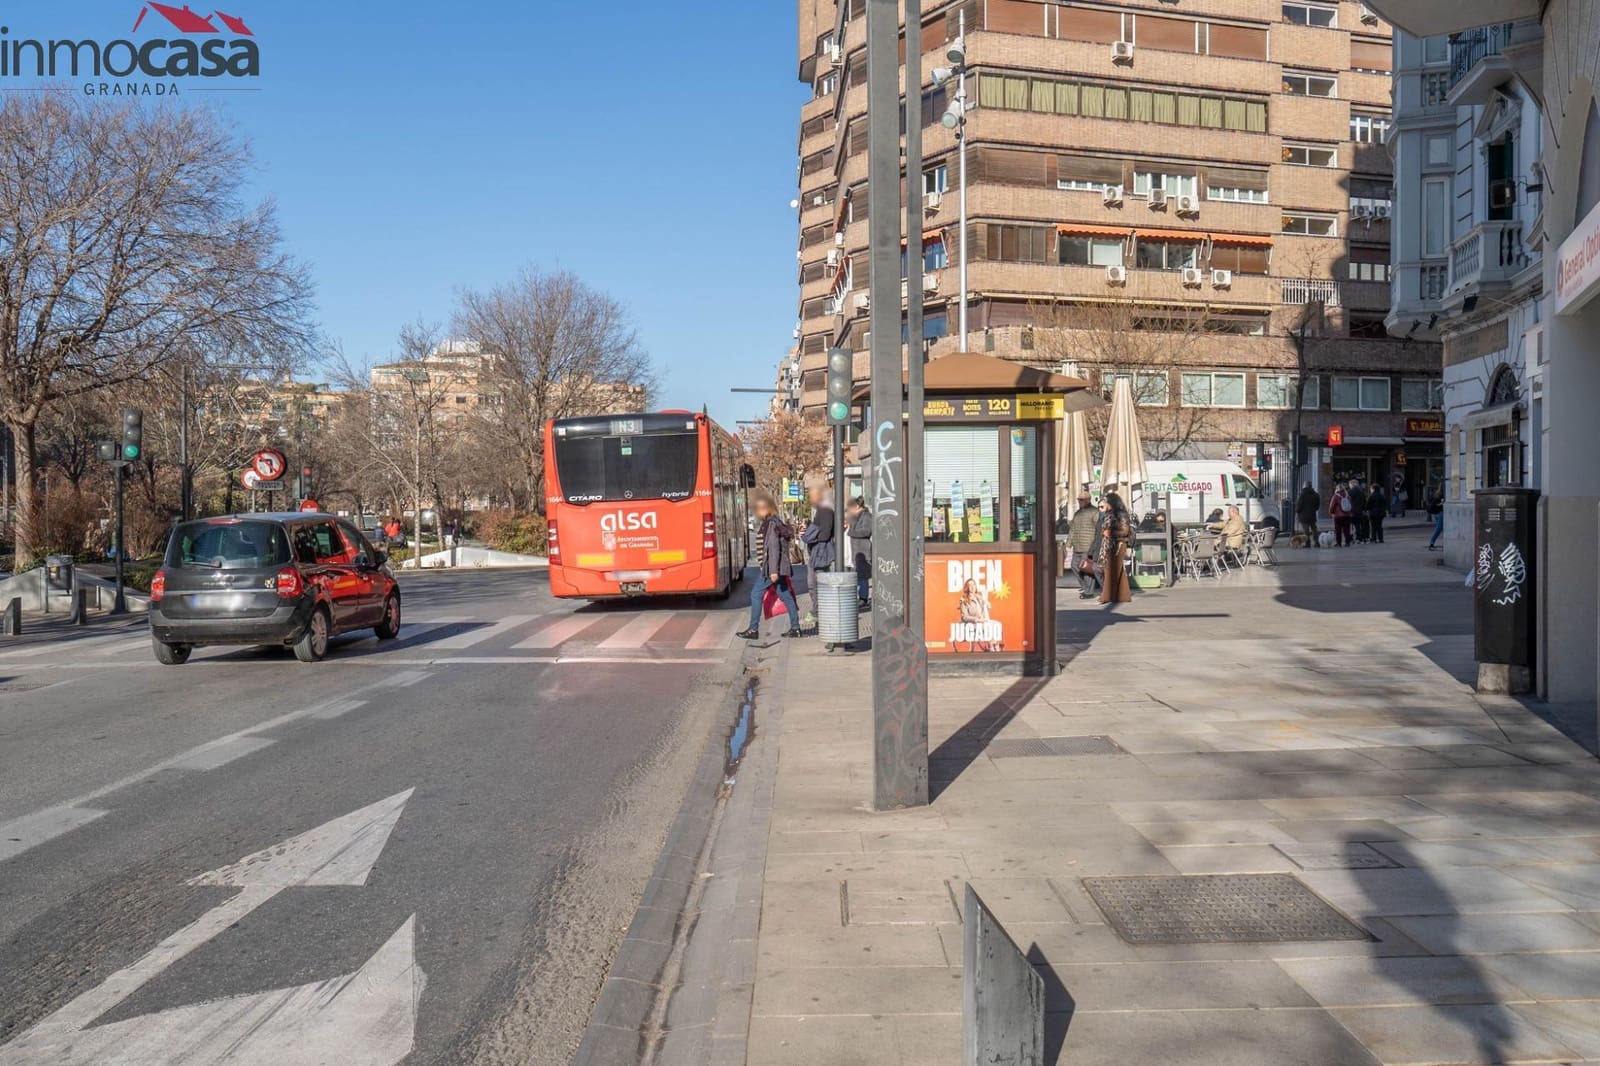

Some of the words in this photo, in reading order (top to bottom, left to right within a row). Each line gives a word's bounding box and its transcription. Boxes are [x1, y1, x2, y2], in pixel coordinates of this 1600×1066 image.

[987, 399, 1010, 410] 120
[600, 510, 657, 531] alsa
[947, 560, 1002, 593] BIEN
[949, 620, 1002, 642] JUGADO
